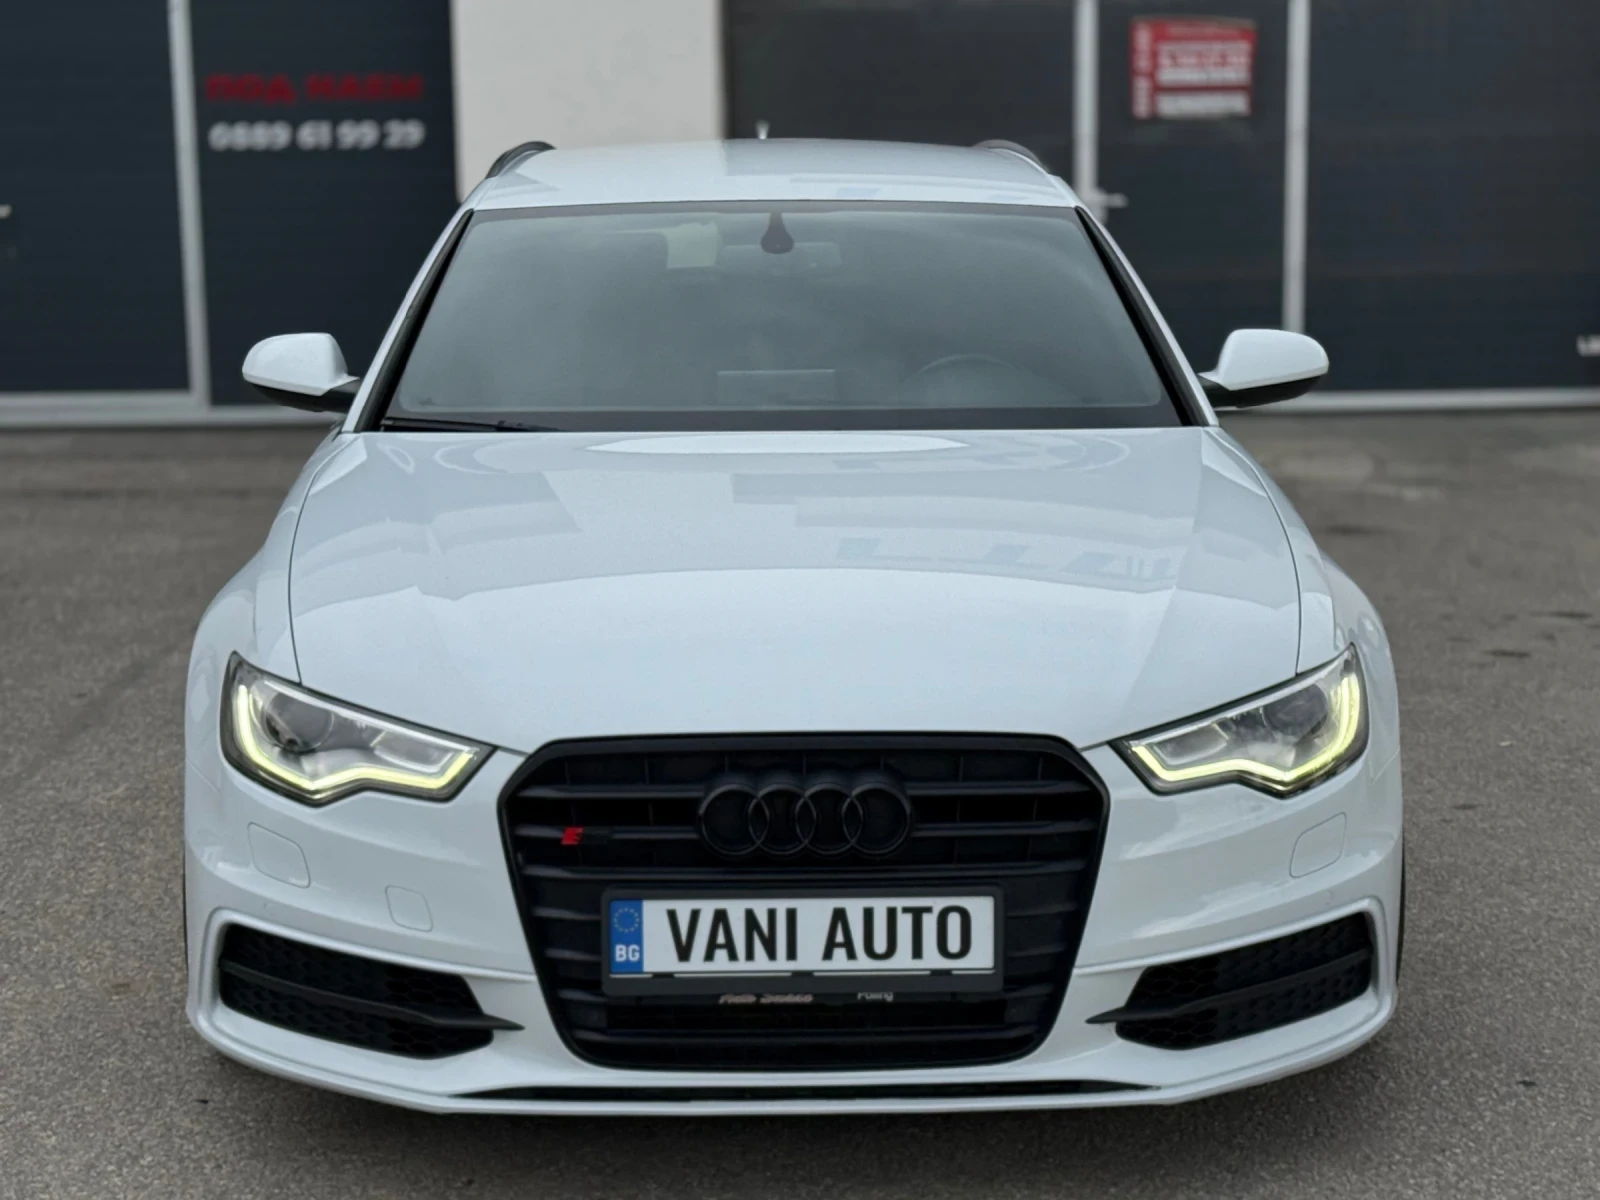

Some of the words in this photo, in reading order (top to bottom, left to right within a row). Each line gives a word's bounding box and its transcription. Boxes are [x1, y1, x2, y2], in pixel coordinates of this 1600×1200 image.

[206, 73, 296, 106] ПОД
[666, 908, 797, 962] VANI
[821, 905, 972, 961] AUTO
[615, 944, 640, 962] BG
